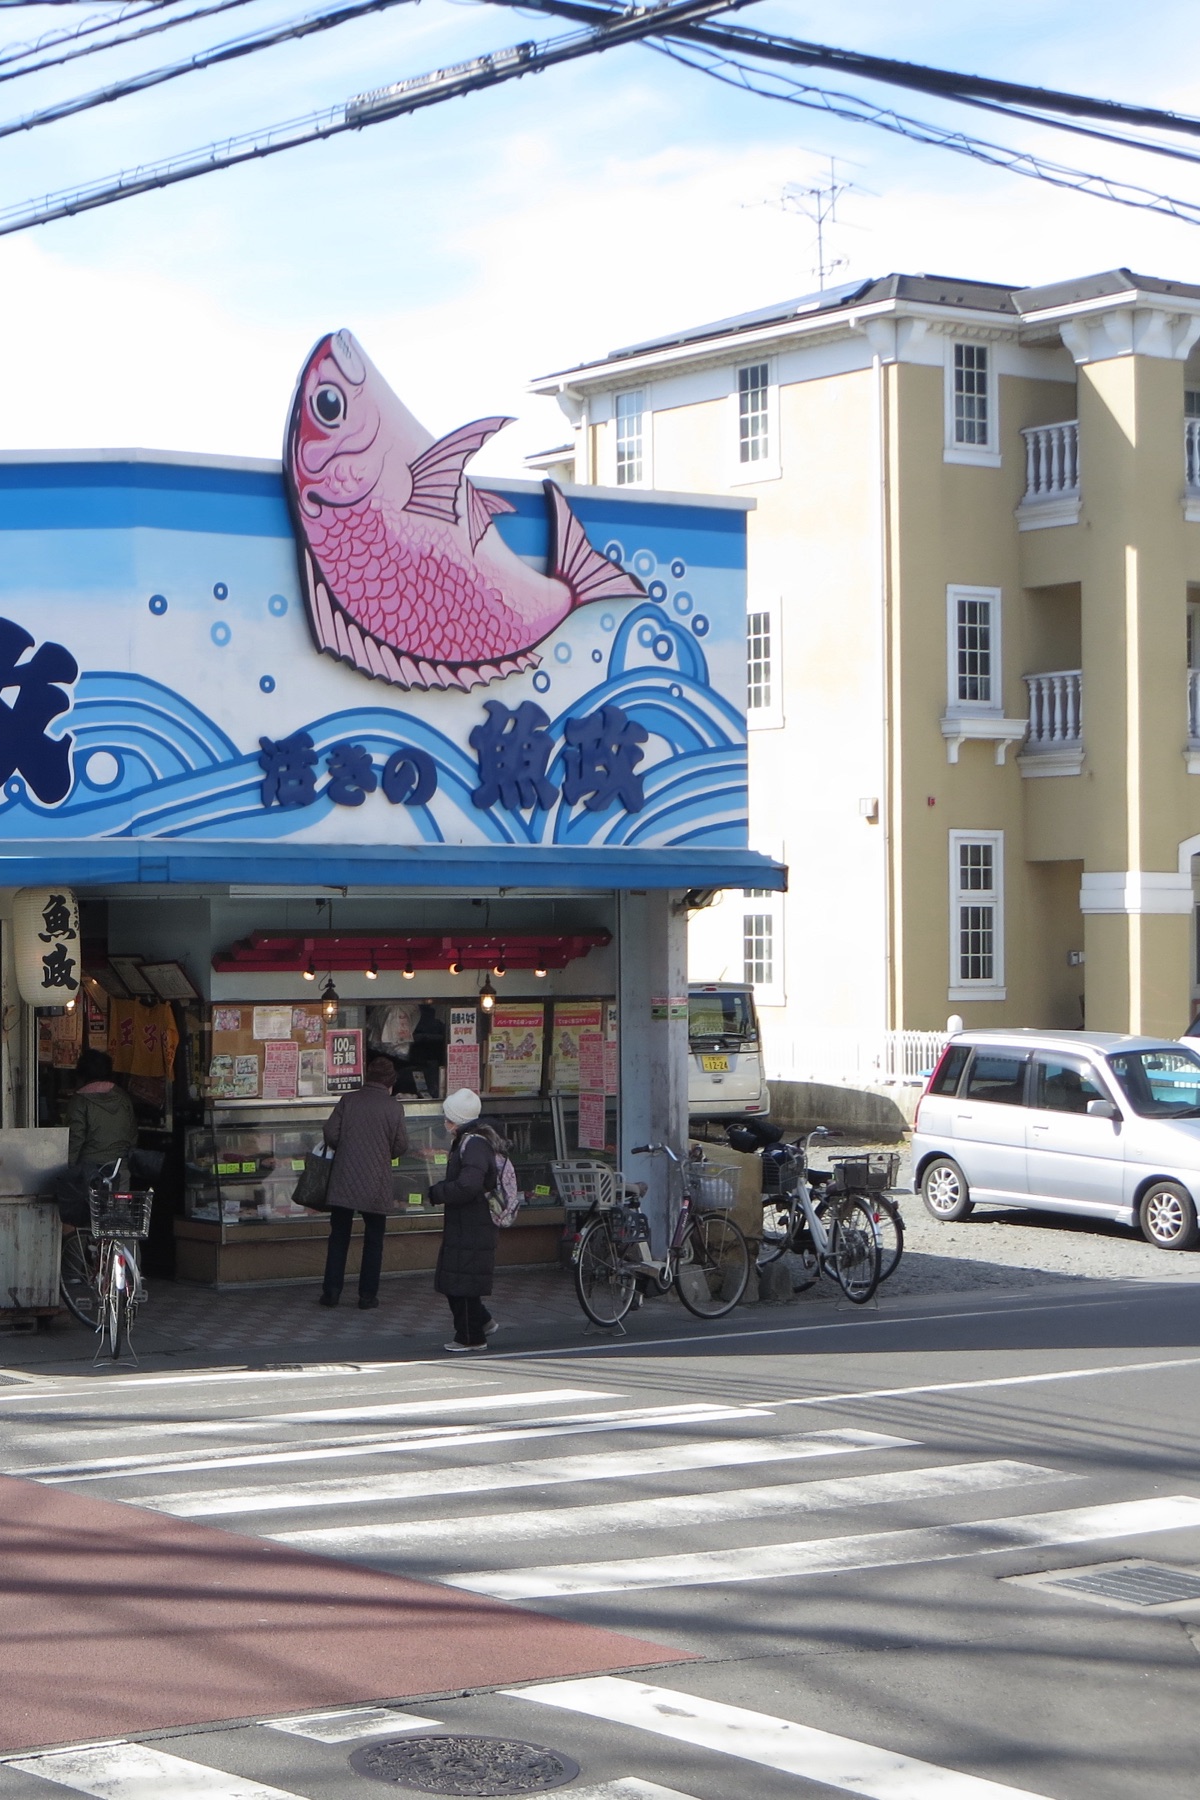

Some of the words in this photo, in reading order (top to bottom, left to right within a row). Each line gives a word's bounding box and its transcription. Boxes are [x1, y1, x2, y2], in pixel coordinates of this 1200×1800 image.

[258, 731, 437, 807] 活きの
[469, 699, 648, 814] 魚政
[37, 894, 79, 991] 魚政
[333, 1037, 356, 1051] 100円
[333, 1051, 356, 1066] 市場
